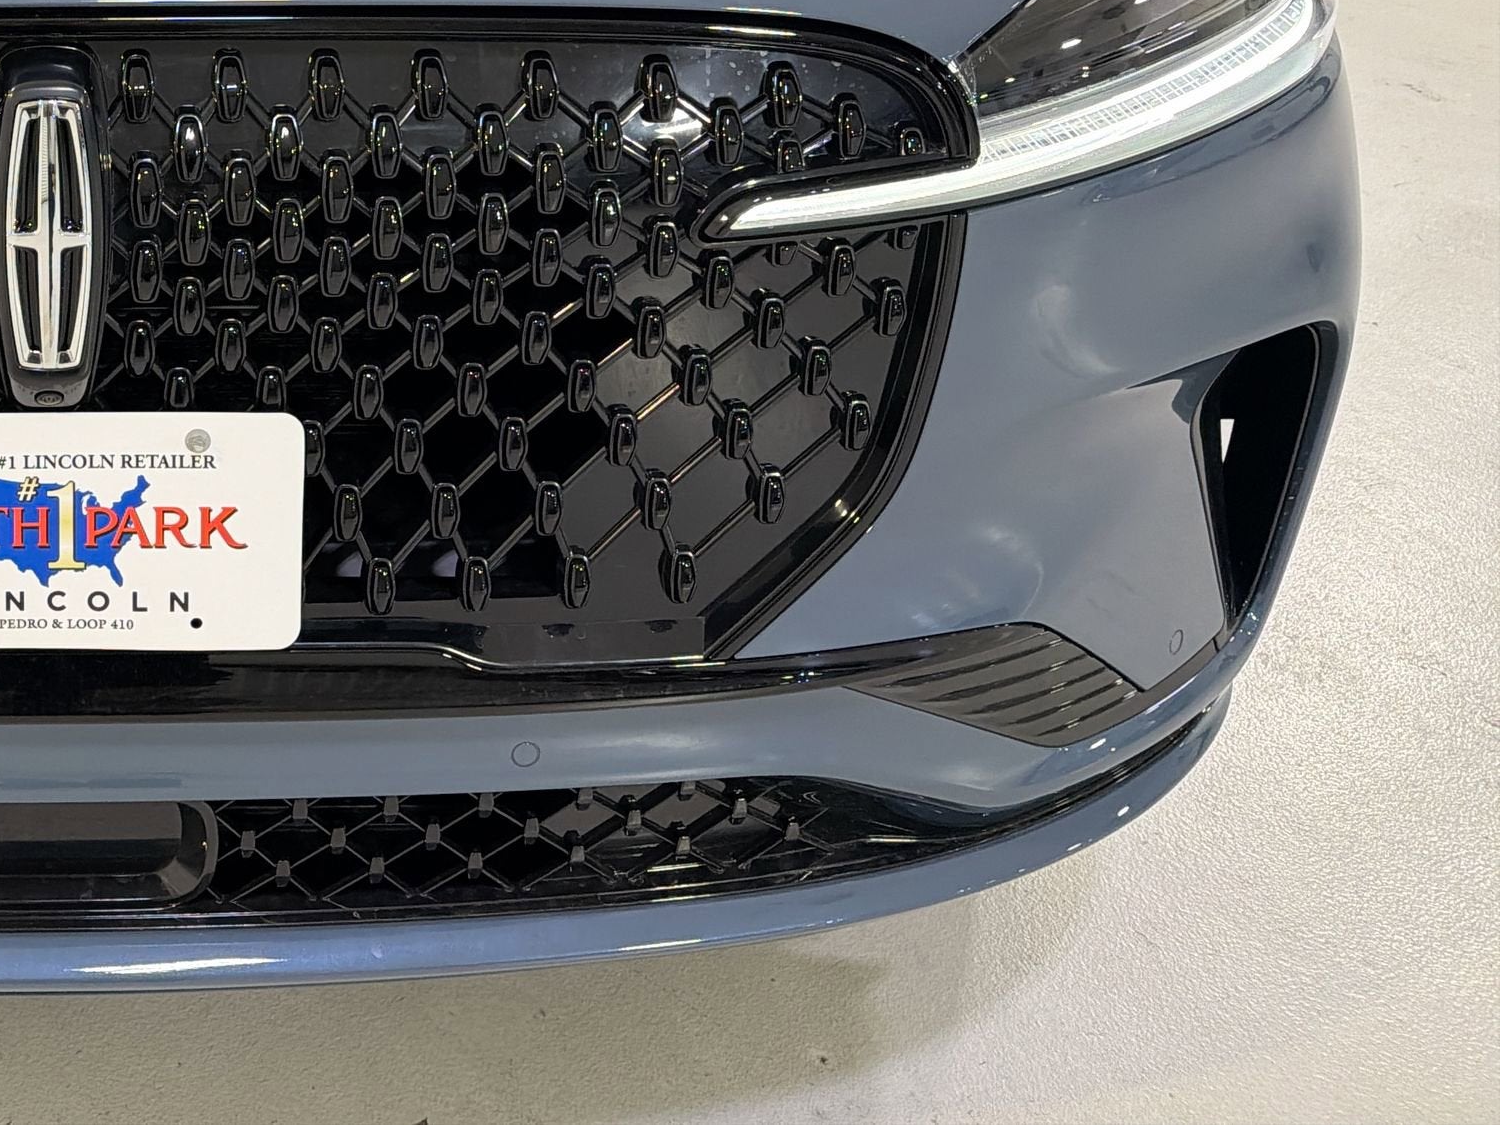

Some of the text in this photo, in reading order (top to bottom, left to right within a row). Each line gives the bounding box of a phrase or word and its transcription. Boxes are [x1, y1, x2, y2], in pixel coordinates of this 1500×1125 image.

[23, 454, 116, 470] LINCOLN
[120, 454, 217, 471] RETAILER
[84, 506, 249, 550] PARK
[0, 618, 49, 630] PEDRO
[51, 619, 64, 630] &
[67, 618, 108, 630] LOOP
[110, 619, 135, 631] 410
